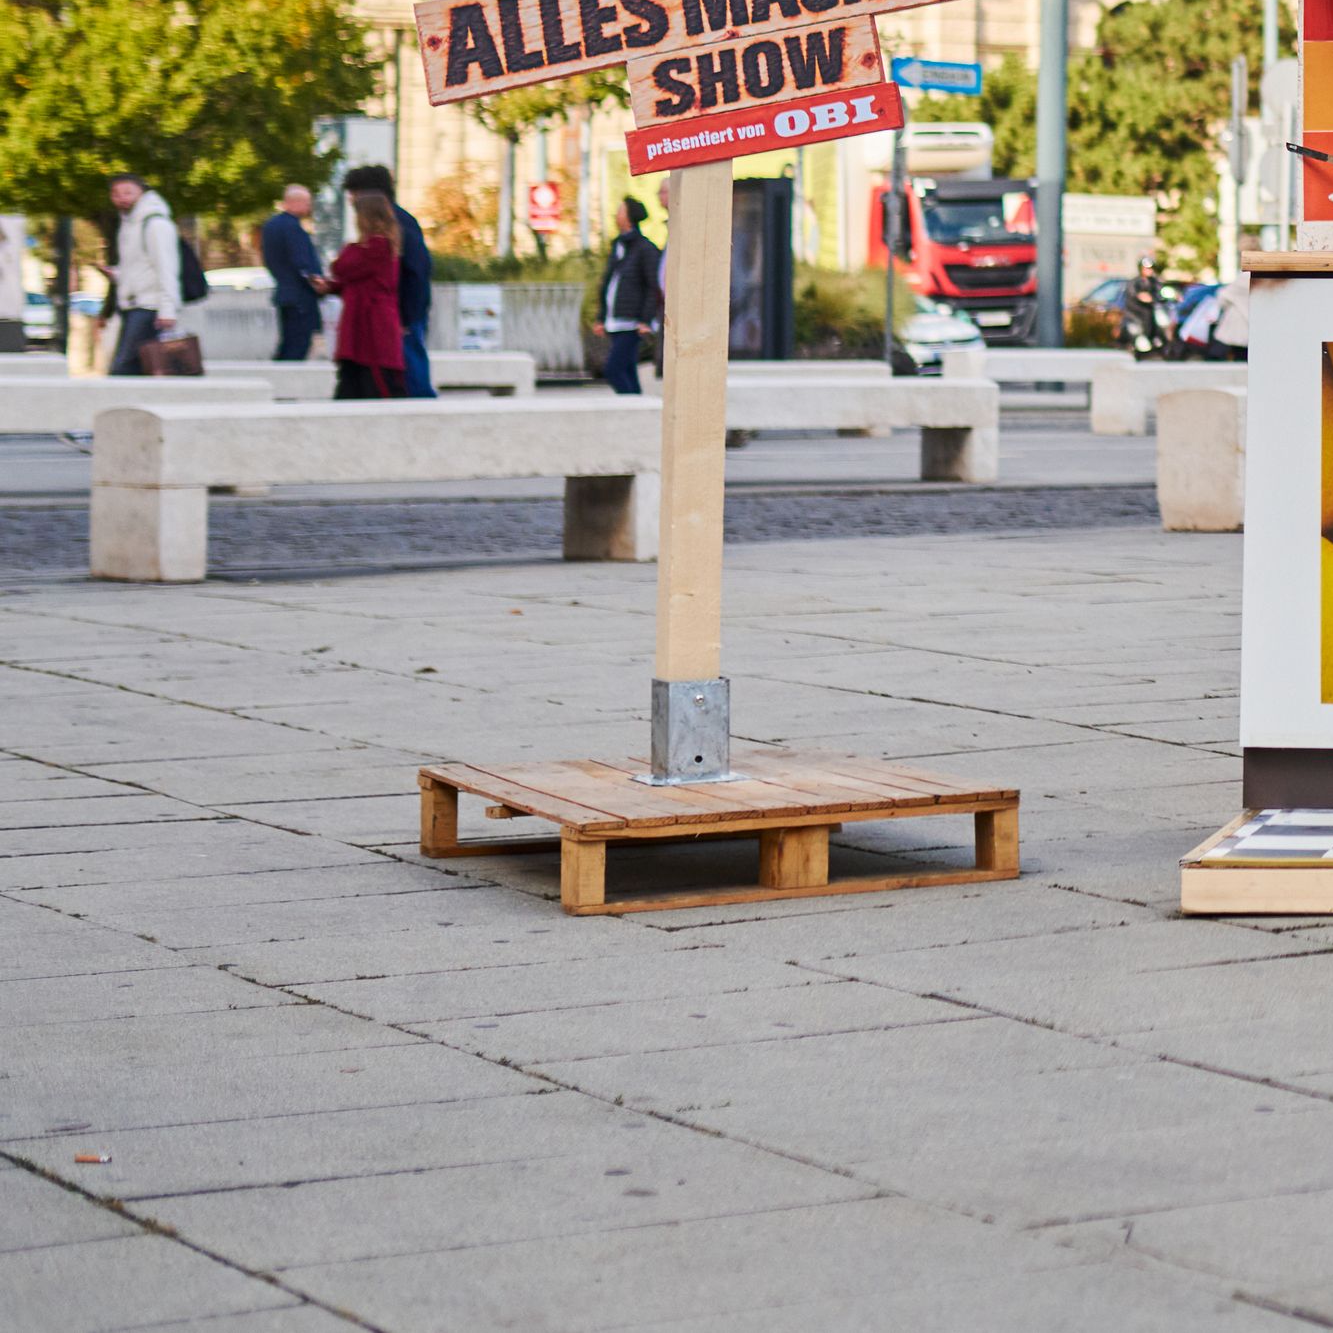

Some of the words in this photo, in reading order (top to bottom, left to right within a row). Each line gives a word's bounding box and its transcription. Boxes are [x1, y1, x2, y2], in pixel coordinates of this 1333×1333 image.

[653, 27, 848, 117] SHOW
[646, 127, 735, 160] präsentiert
[737, 123, 766, 141] von
[773, 95, 879, 138] OBI
